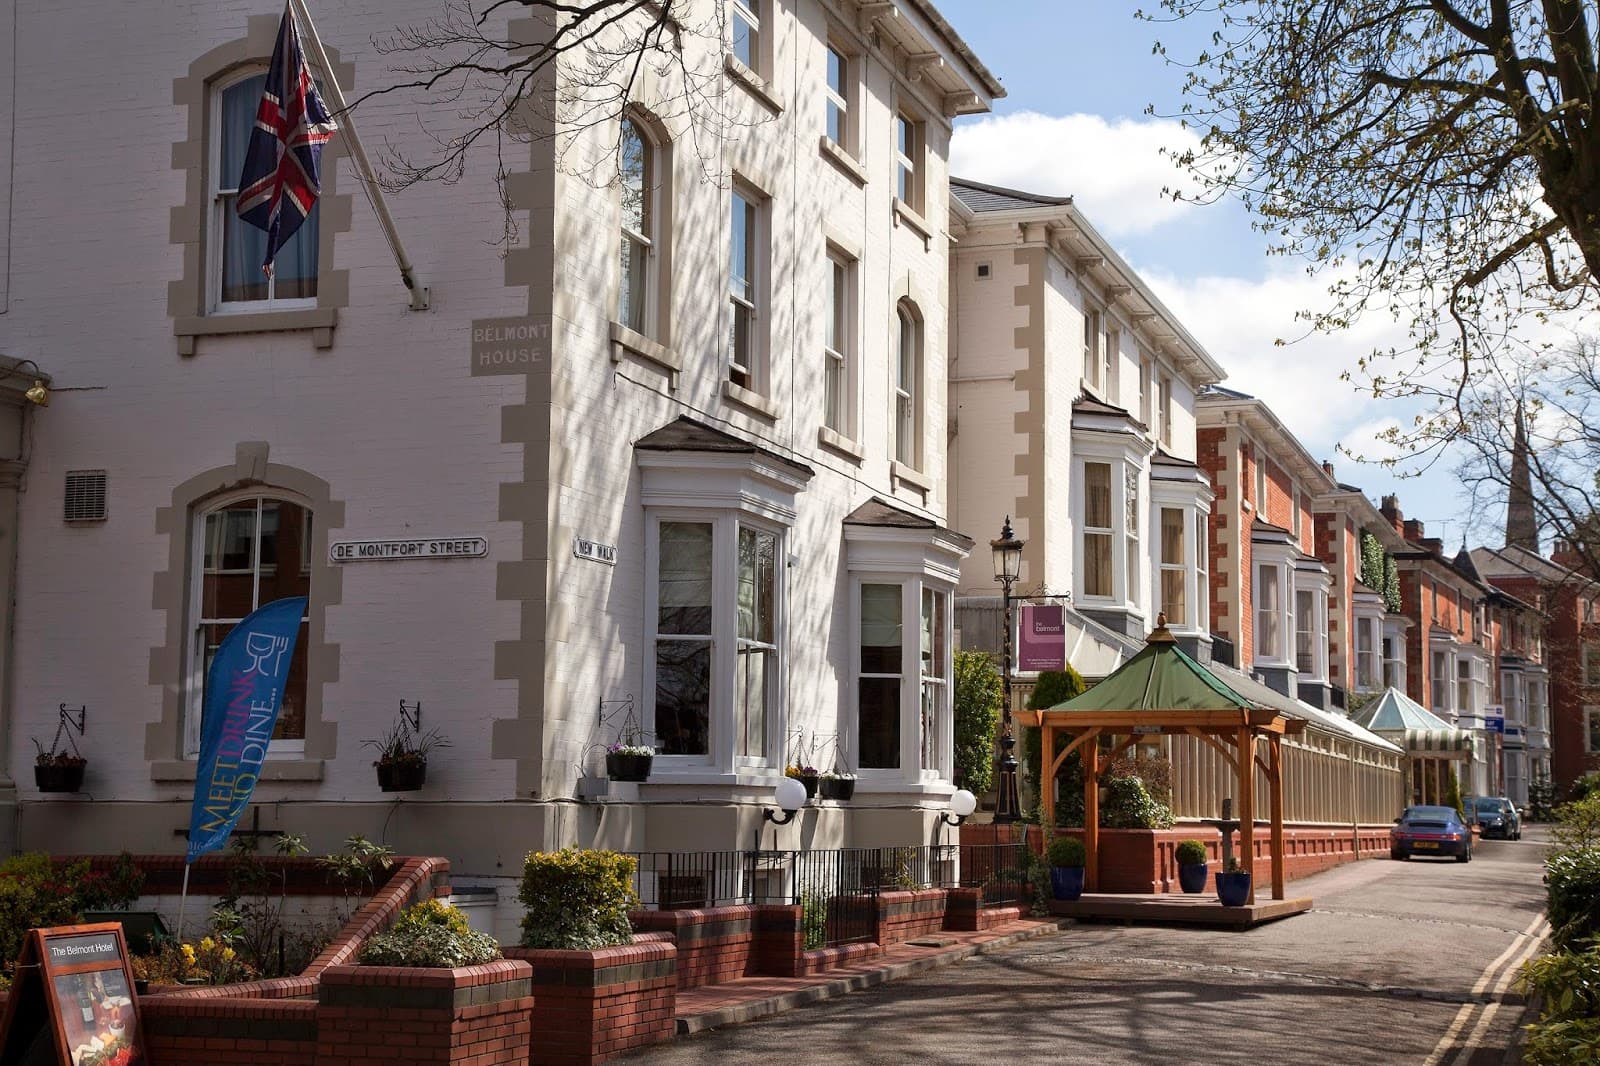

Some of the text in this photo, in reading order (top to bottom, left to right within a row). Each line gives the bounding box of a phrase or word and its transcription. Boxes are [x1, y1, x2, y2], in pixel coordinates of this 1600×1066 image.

[474, 324, 550, 342] BELMONT
[480, 348, 542, 365] HOUSE
[337, 541, 479, 557] DE MONTFORT STREET
[579, 541, 592, 555] NEW
[52, 943, 114, 957] The Belmont Hotel
